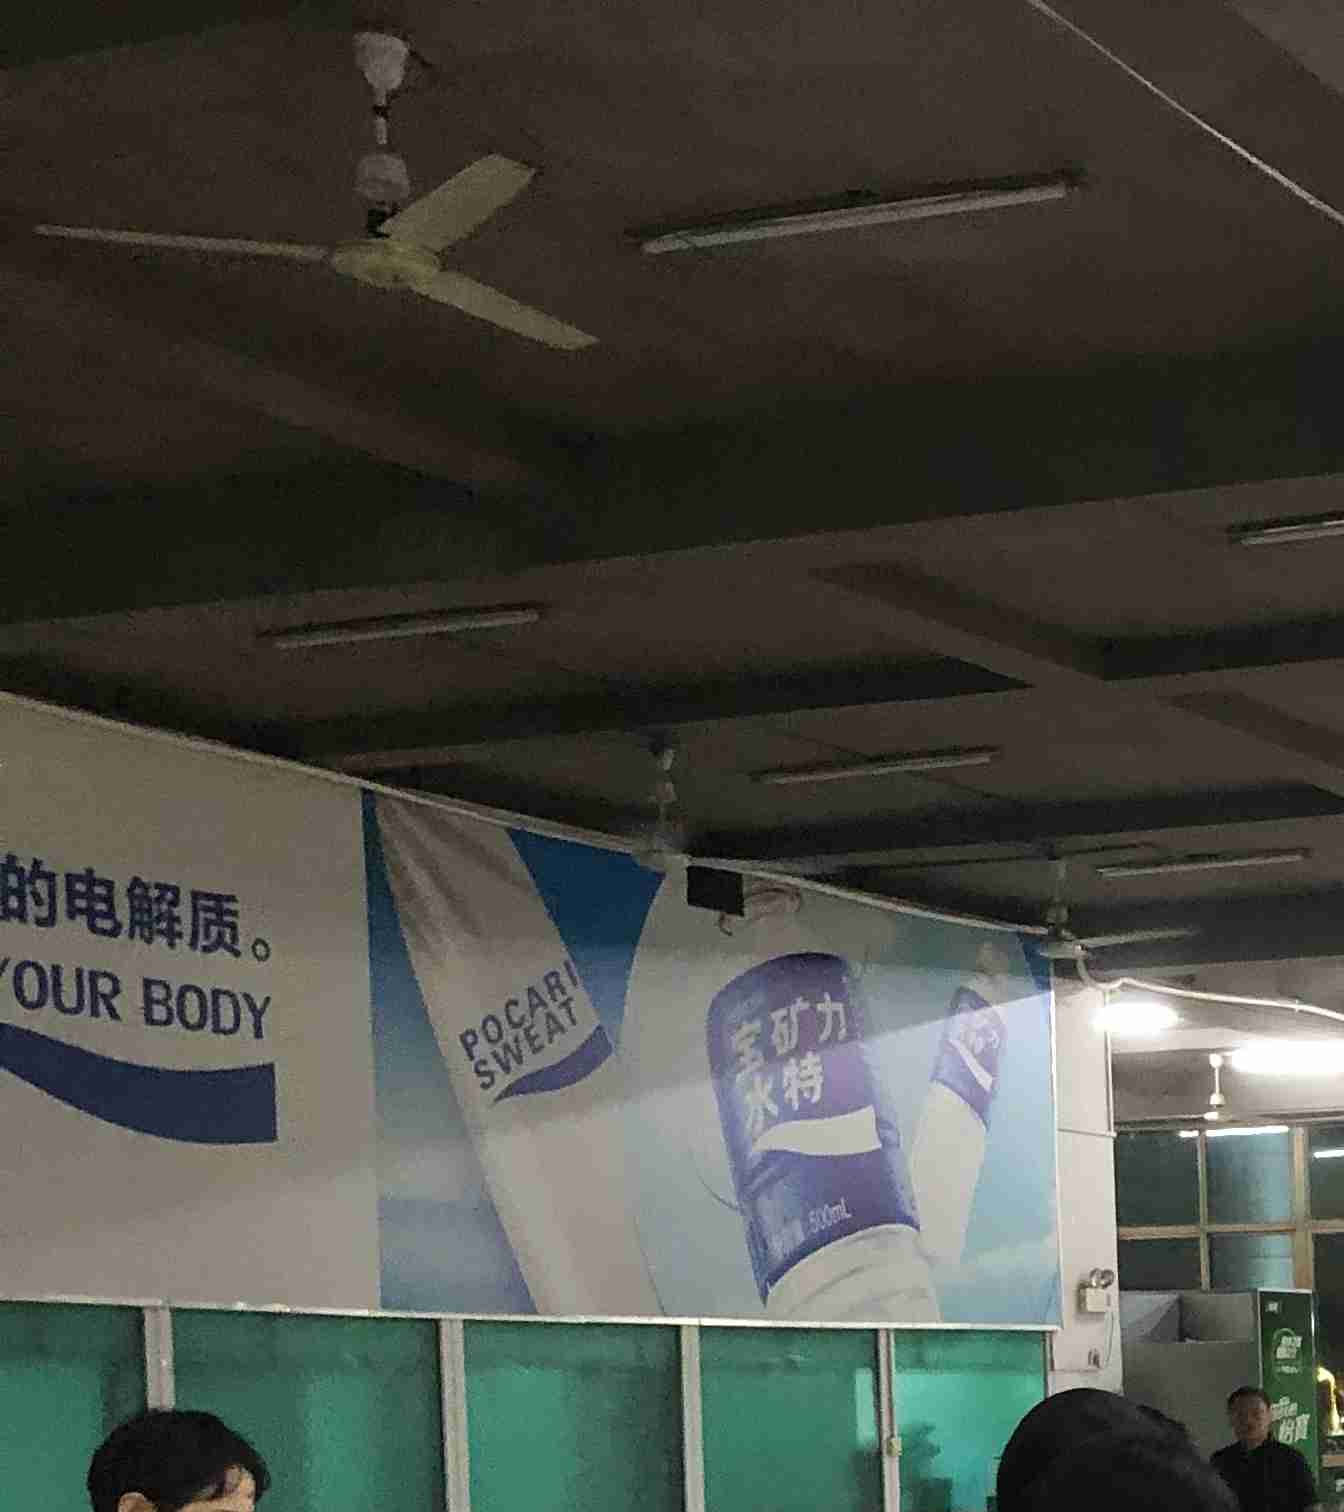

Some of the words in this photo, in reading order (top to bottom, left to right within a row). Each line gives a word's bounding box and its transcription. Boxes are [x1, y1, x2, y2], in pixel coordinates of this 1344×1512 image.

[0, 851, 271, 963] 的电解质。
[0, 956, 122, 1022] OUR
[142, 975, 271, 1040] BODY
[459, 959, 579, 1061] POCARI
[474, 996, 577, 1090] SWEAT
